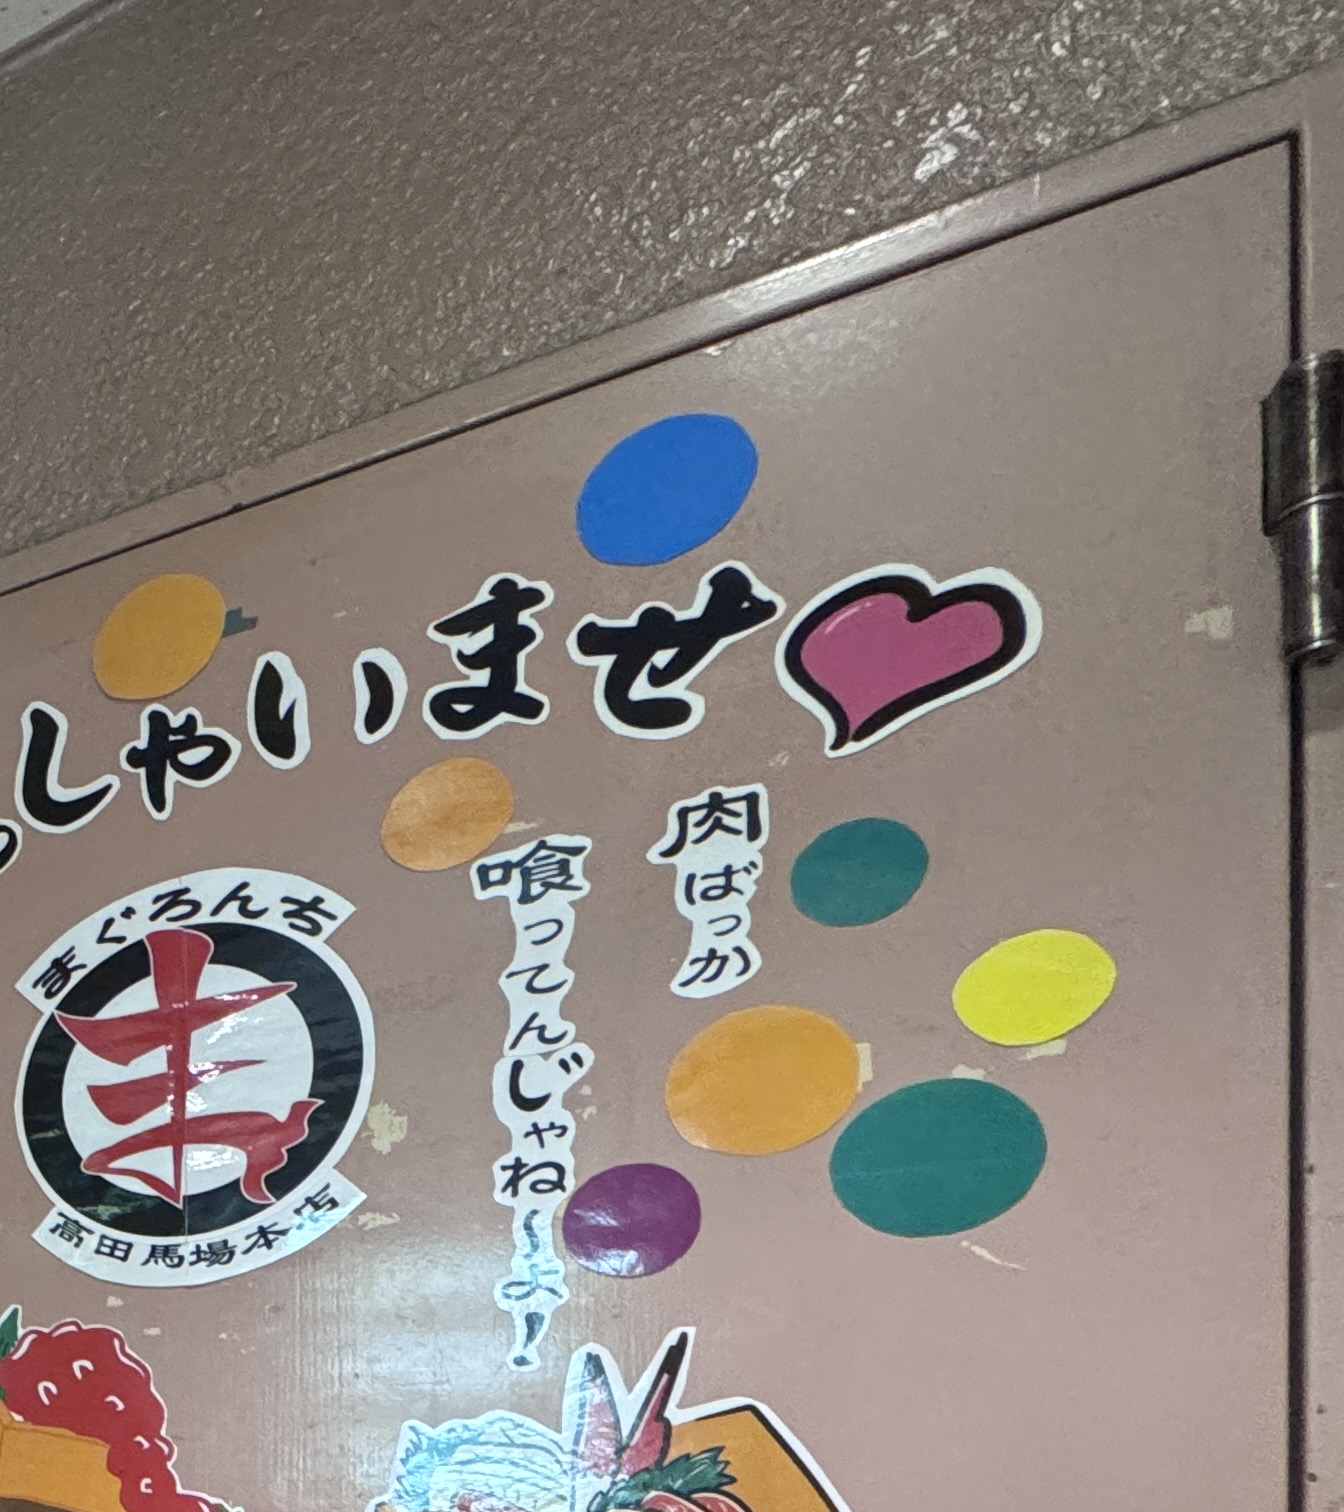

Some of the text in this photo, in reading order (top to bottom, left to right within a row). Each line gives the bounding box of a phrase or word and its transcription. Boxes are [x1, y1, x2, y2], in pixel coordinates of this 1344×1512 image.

[31, 882, 339, 1000] まぐろんち
[660, 791, 761, 989] 肉ばっか
[48, 1184, 341, 1268] 高田馬場本店
